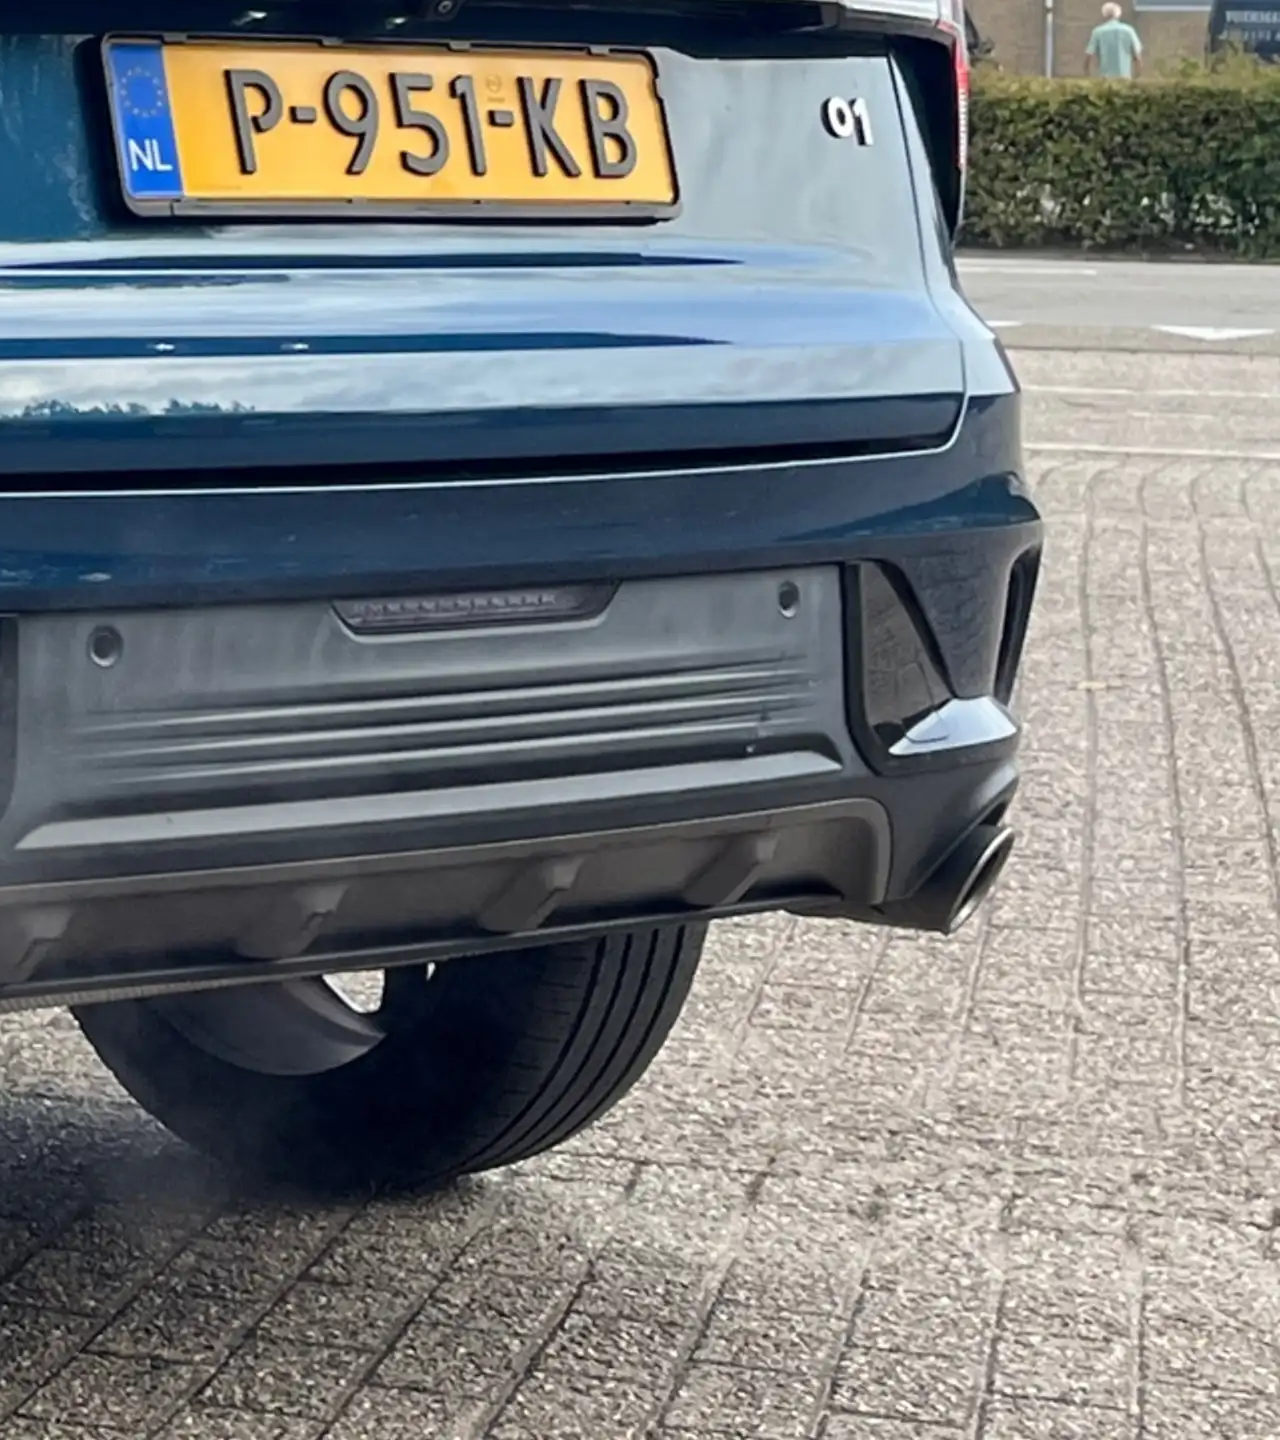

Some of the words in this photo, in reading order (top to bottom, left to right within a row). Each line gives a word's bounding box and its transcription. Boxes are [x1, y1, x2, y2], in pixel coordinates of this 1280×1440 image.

[130, 138, 173, 173] NL
[225, 68, 639, 180] P-951-KB
[820, 95, 874, 147] 01
